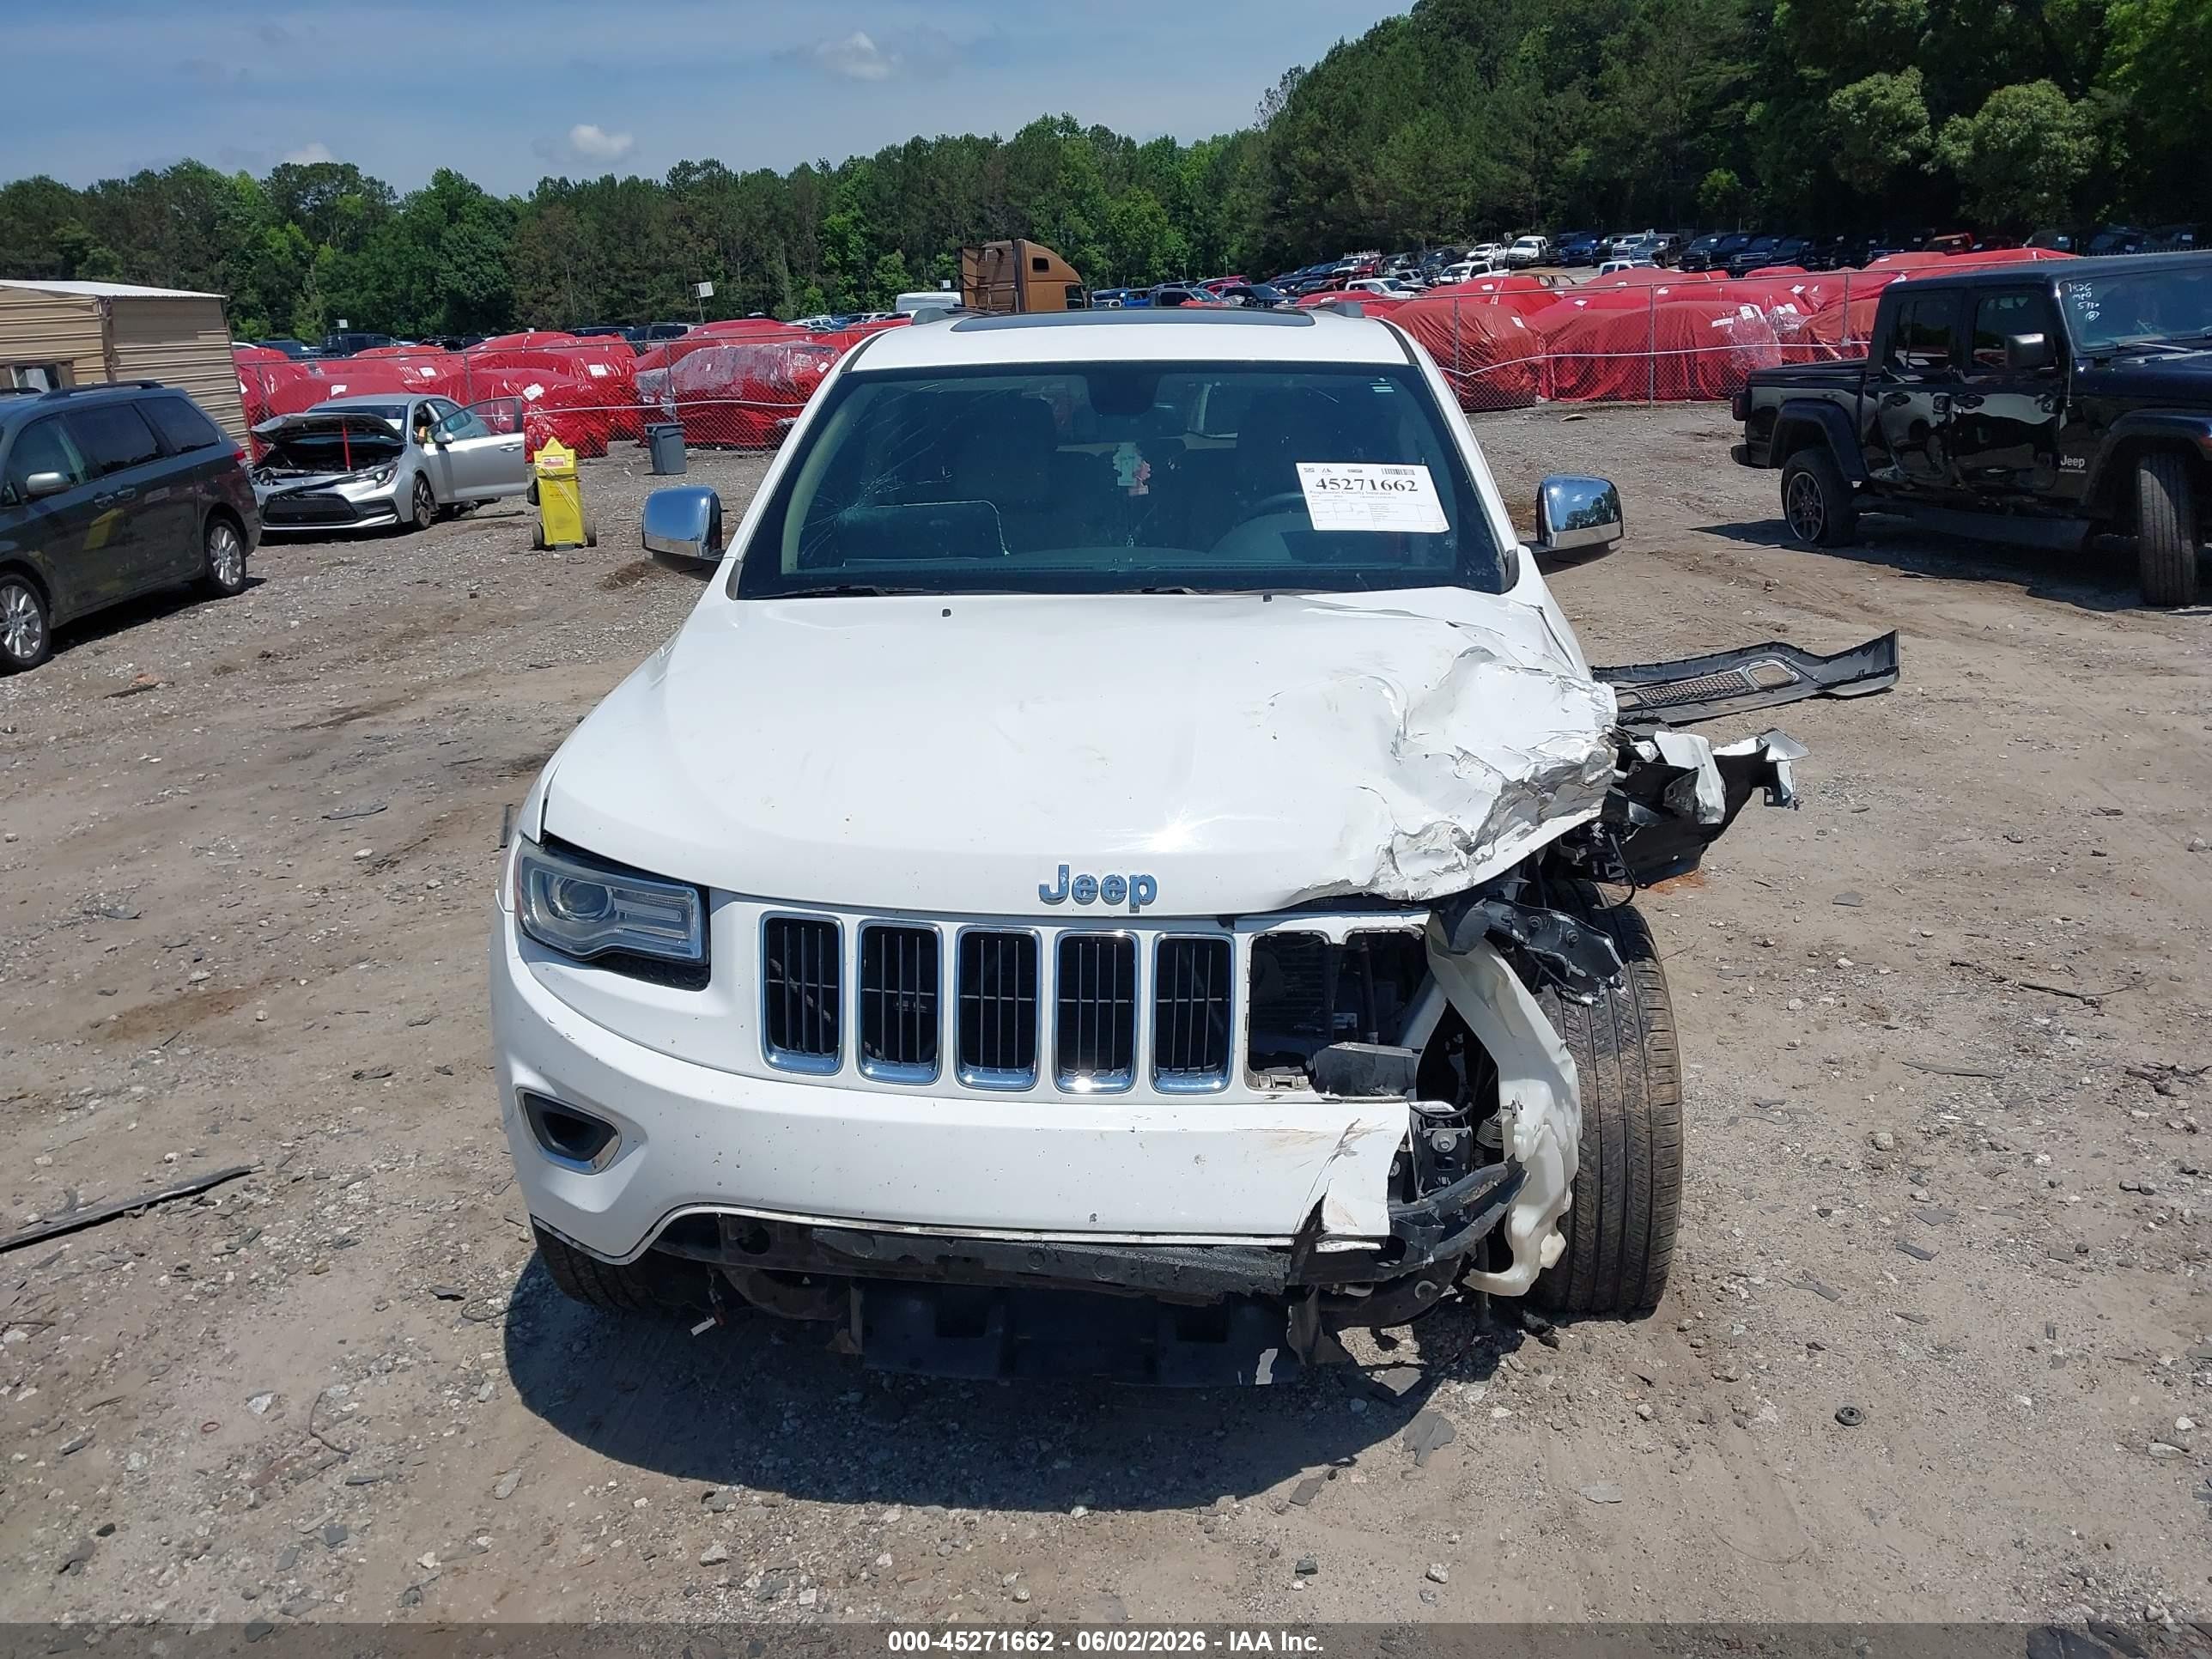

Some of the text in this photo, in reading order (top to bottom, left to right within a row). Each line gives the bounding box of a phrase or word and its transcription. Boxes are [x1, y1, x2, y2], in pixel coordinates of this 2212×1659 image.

[2060, 454, 2086, 468] Jeep
[1316, 477, 1419, 492] 45271662
[1038, 864, 1158, 914] Jeep
